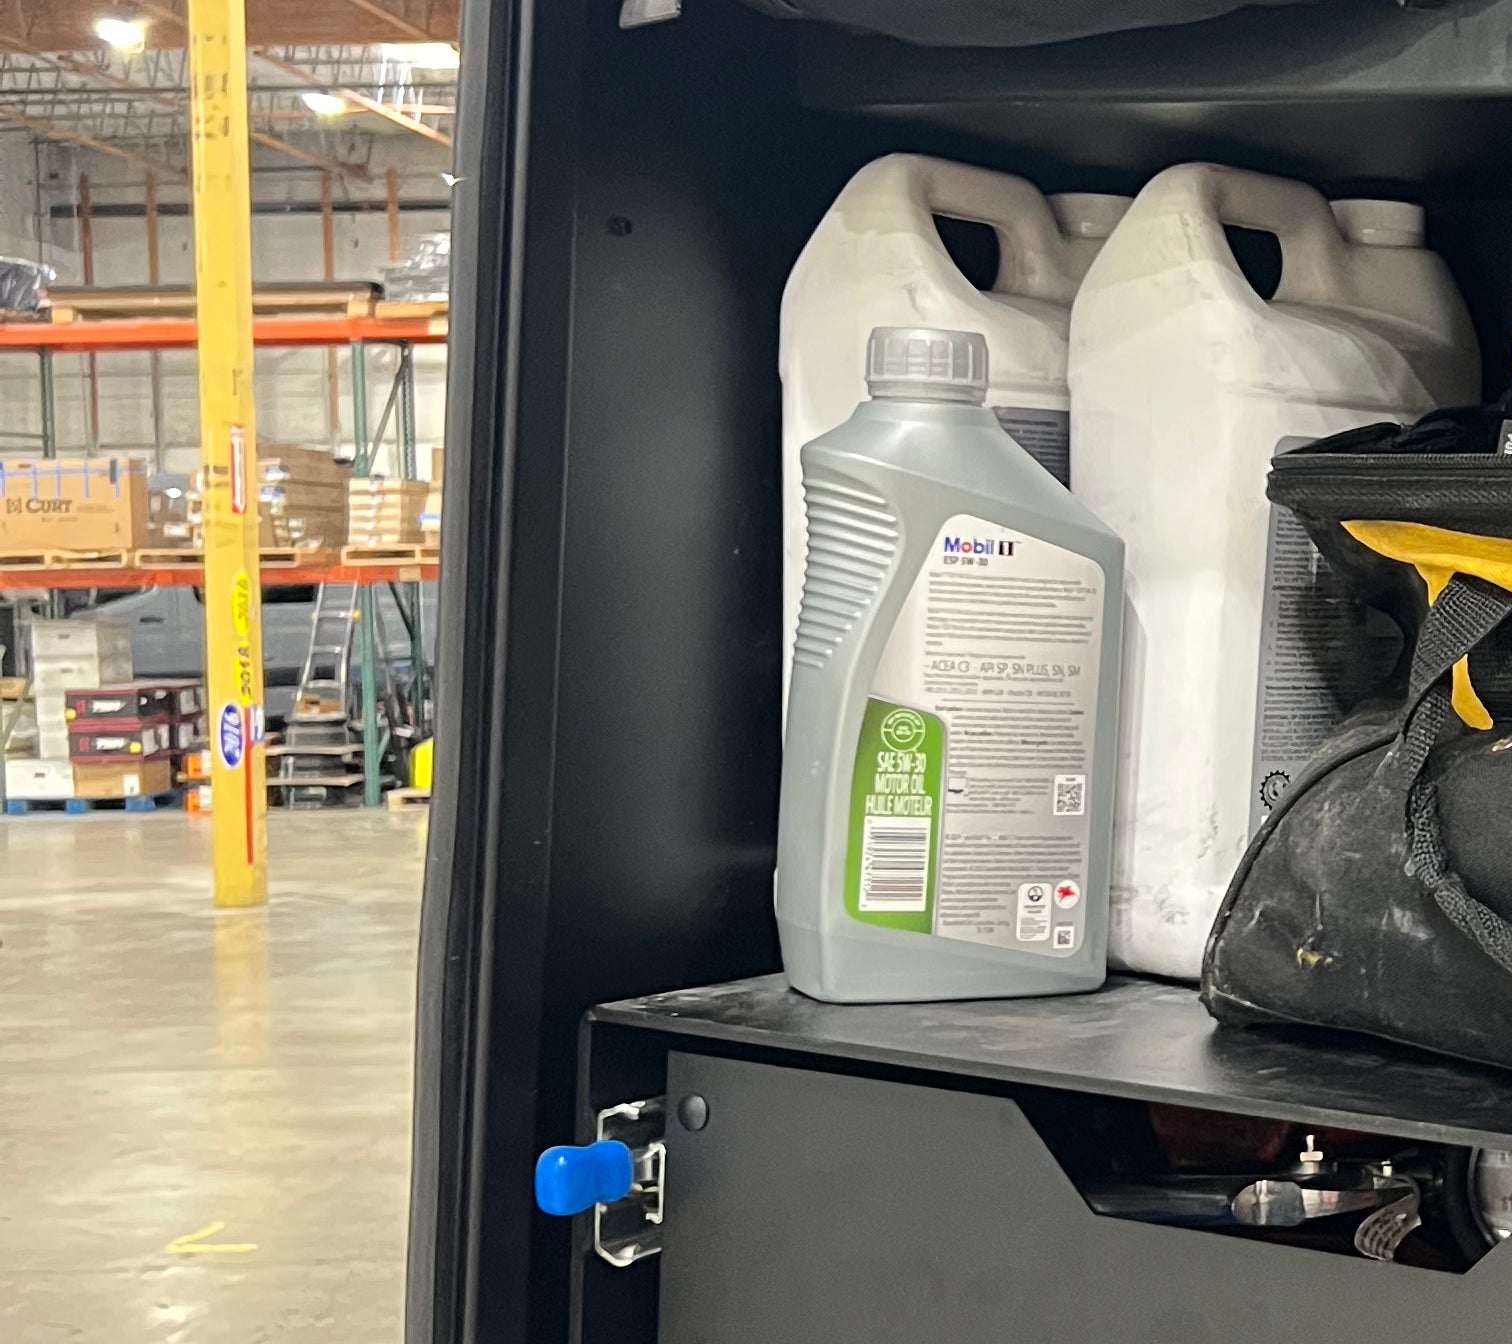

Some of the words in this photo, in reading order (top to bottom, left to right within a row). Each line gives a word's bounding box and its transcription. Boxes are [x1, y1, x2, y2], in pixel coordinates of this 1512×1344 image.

[26, 499, 73, 514] CURT
[944, 536, 995, 555] Mobil
[875, 773, 910, 794] MOTOR
